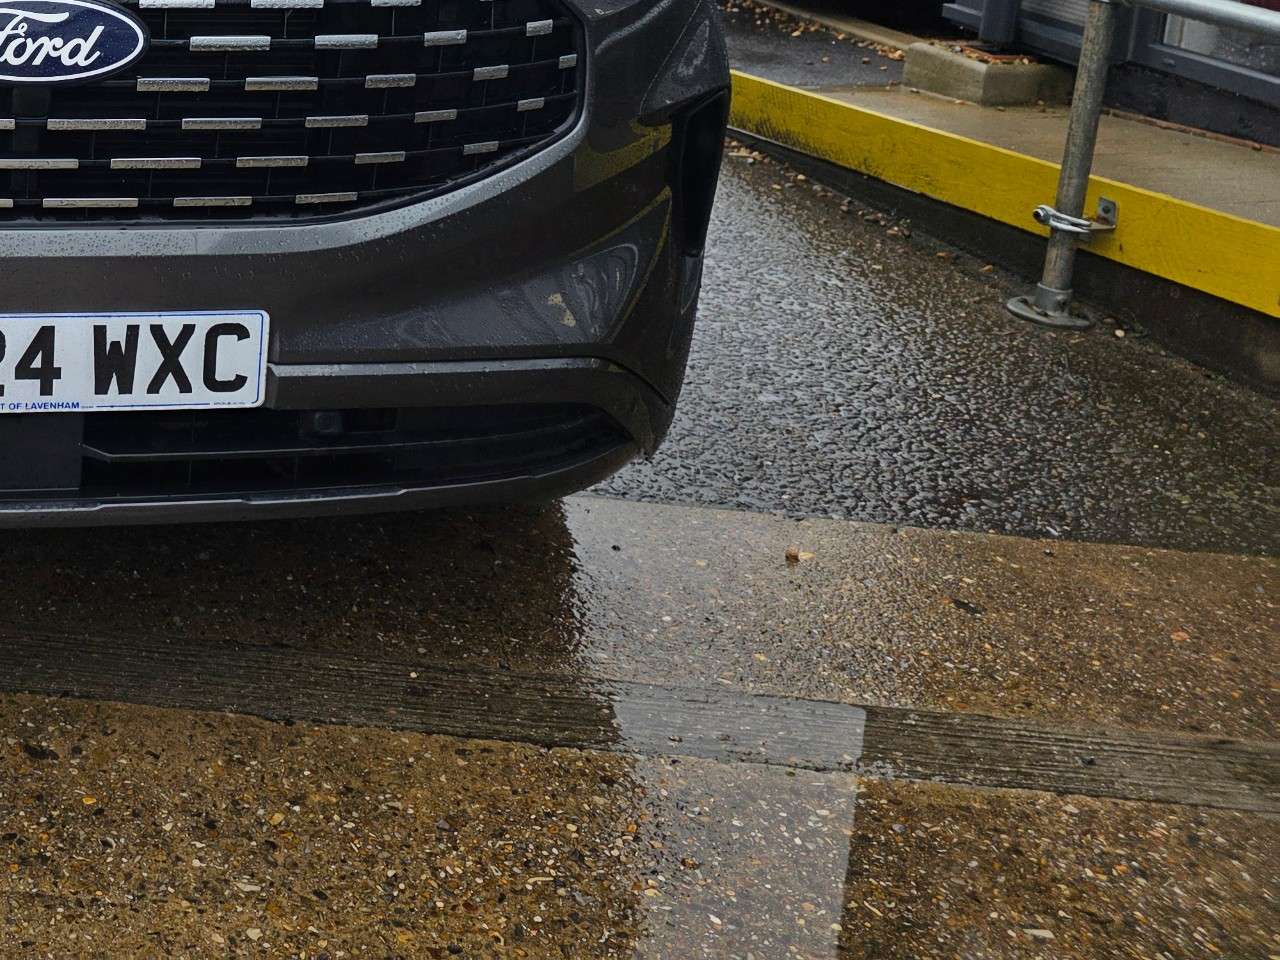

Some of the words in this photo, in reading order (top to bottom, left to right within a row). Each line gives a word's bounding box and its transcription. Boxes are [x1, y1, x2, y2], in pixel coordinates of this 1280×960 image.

[93, 322, 251, 395] WXC
[8, 402, 21, 411] OF
[25, 401, 80, 411] LAVENHAM
